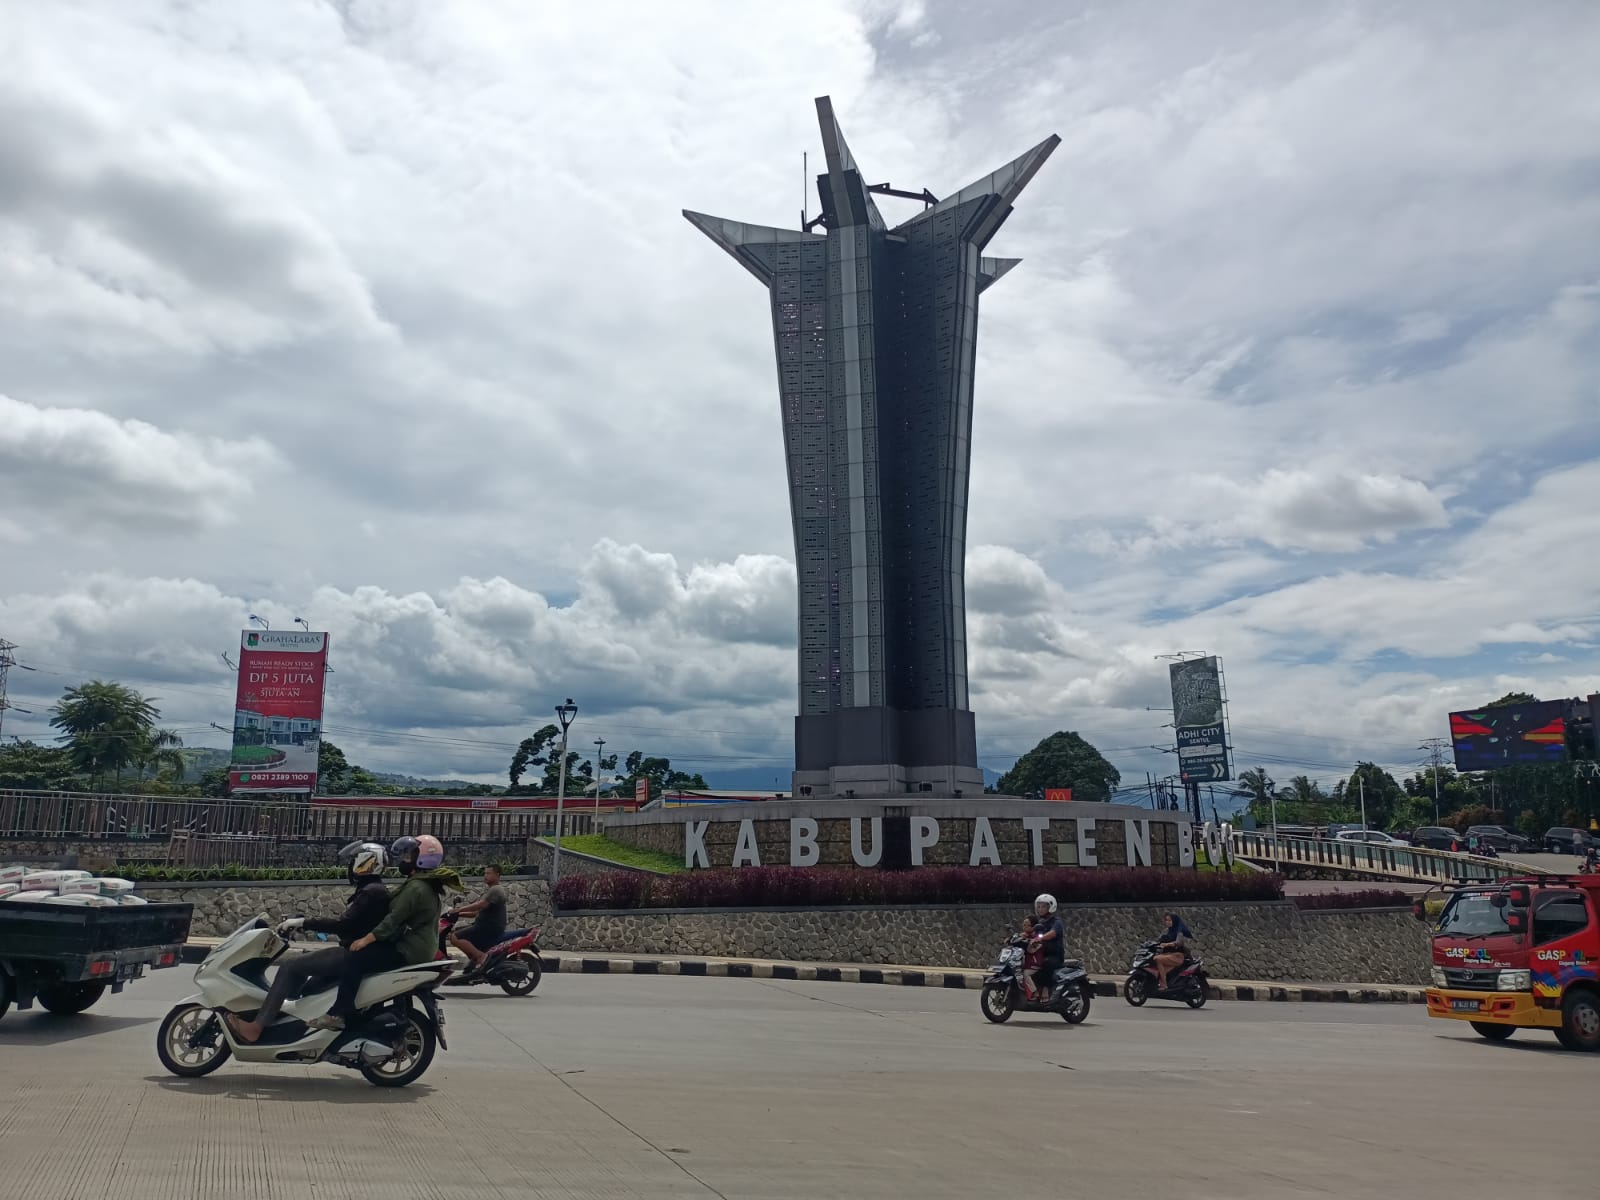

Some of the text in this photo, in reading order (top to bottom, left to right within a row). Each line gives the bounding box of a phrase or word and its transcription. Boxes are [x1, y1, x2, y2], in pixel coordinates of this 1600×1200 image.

[249, 672, 314, 685] DP 5 JUTA
[1178, 727, 1221, 739] ADHI CITY
[685, 817, 1152, 868] KABUPATEN
[1445, 947, 1491, 959] GASPOOL
